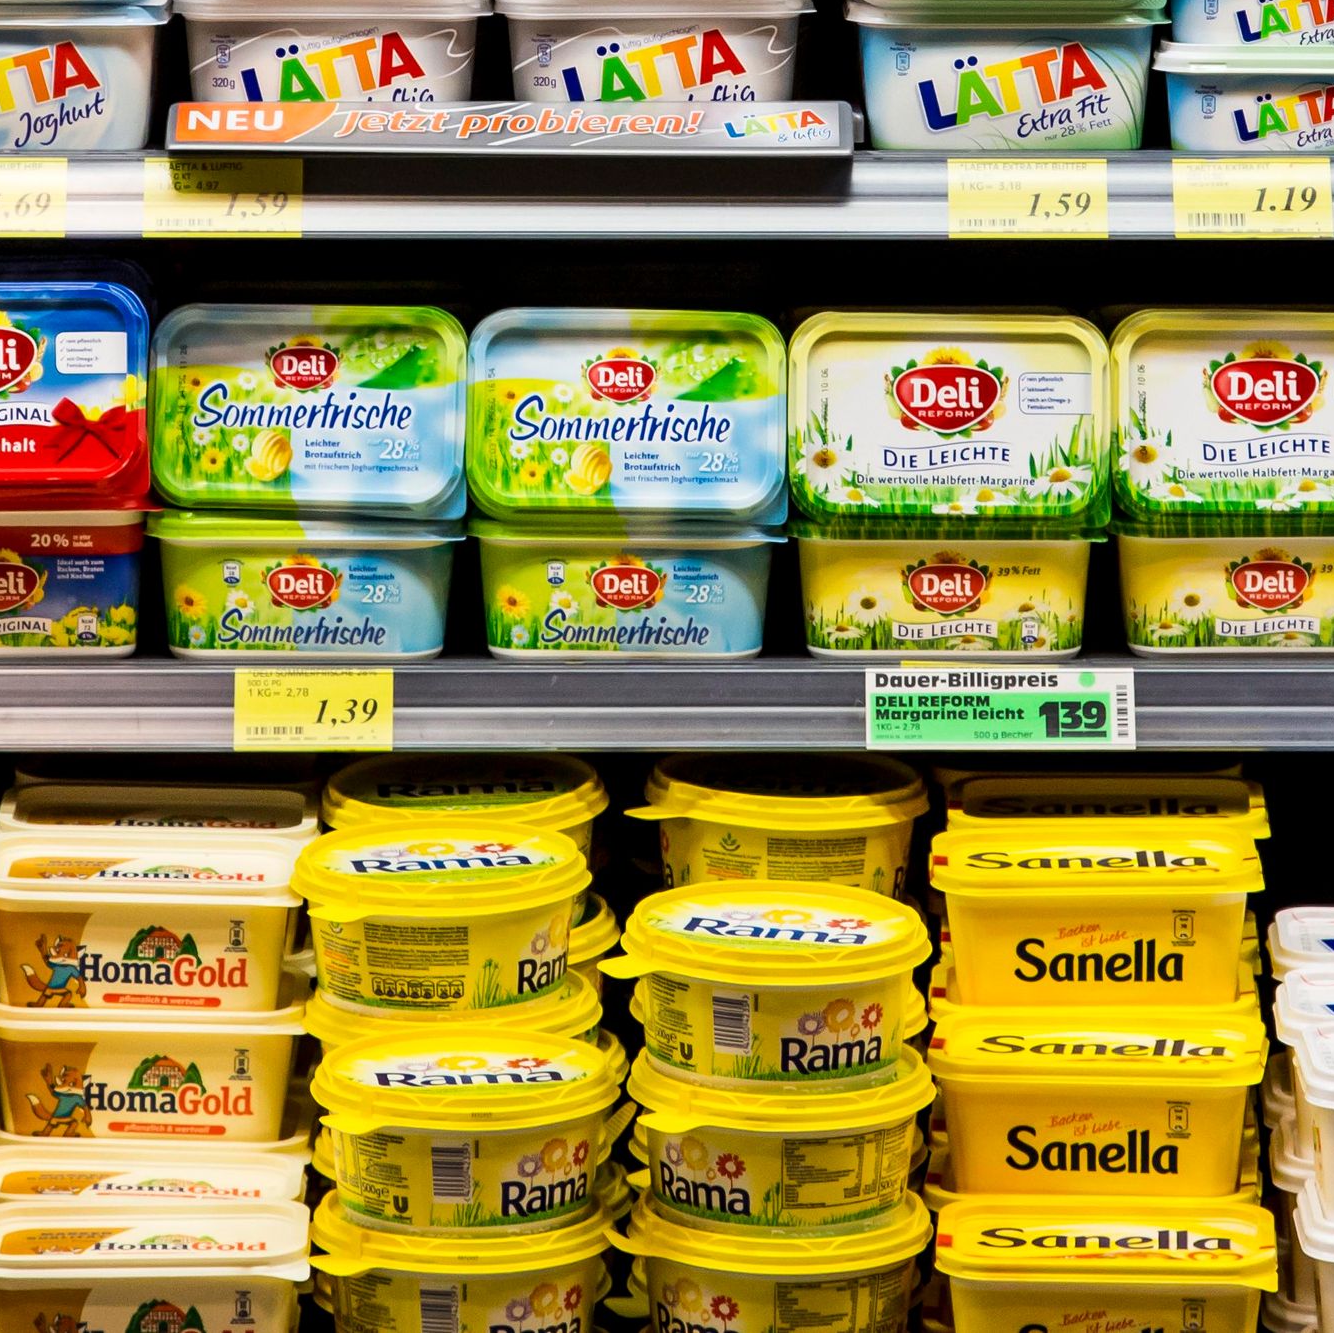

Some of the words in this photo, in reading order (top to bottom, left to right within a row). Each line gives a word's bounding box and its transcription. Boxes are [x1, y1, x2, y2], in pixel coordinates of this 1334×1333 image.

[186, 110, 283, 130] NEU
[338, 108, 448, 135] Jetzt
[458, 110, 702, 138] probieren!
[1060, 123, 1086, 138] 28%
[1088, 118, 1112, 130] Fett
[1252, 187, 1316, 212] 1.19
[192, 383, 413, 431] Sommerfrische
[305, 450, 361, 460] Brotaufstrich
[883, 447, 919, 467] DIE
[924, 445, 1010, 465] LEICHTE
[857, 473, 875, 484] Die
[880, 473, 928, 486] wertvolle
[932, 475, 1035, 487] Halbfett-Margarine
[1243, 571, 1294, 594] Deli
[875, 674, 1058, 692] Dauer-Billigpreis
[875, 696, 913, 707] DELI
[918, 696, 990, 707] REFORM
[875, 709, 967, 723] Margarine
[973, 708, 1025, 721] leicht
[352, 849, 532, 875] Rama
[84, 957, 248, 988] HomaGold
[1016, 940, 1184, 983] Sanella
[781, 1034, 882, 1071] Rama
